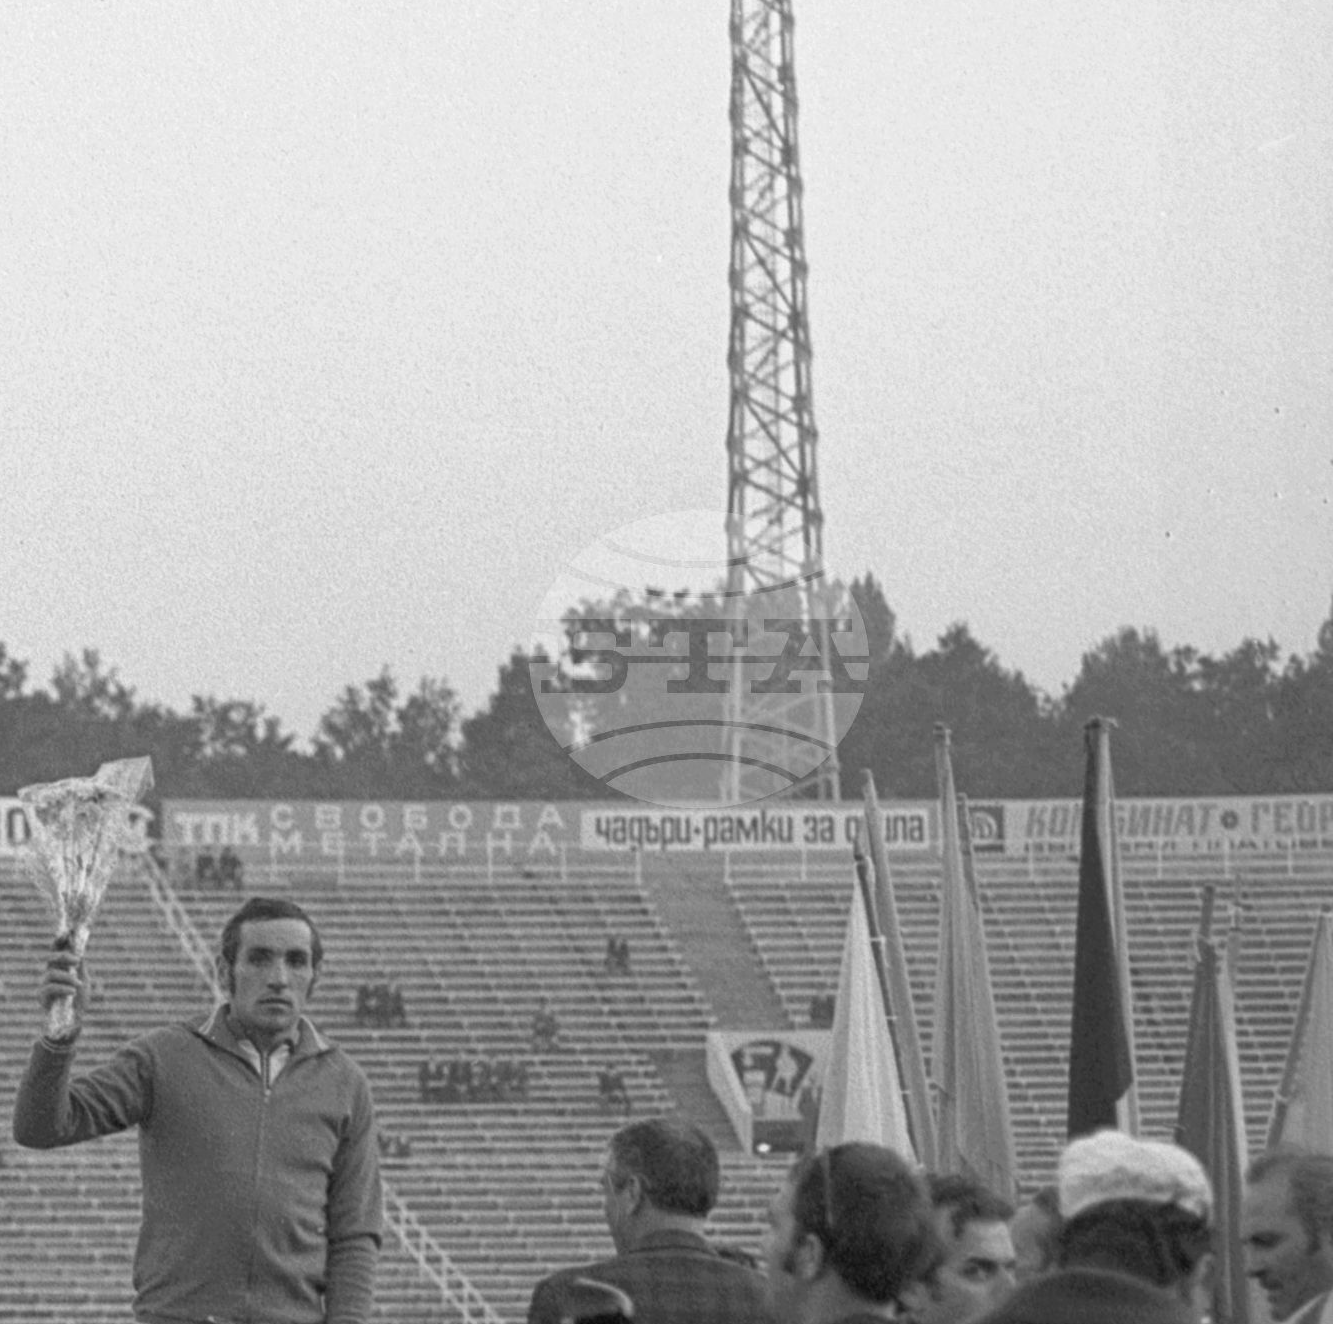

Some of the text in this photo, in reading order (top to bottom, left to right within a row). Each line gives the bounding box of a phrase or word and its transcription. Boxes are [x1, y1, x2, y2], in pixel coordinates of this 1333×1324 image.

[270, 803, 564, 831] СВОБОДА
[803, 815, 834, 844] за
[1025, 803, 1218, 837] КОИНАТ
[269, 830, 558, 857] МЕТАЛНА
